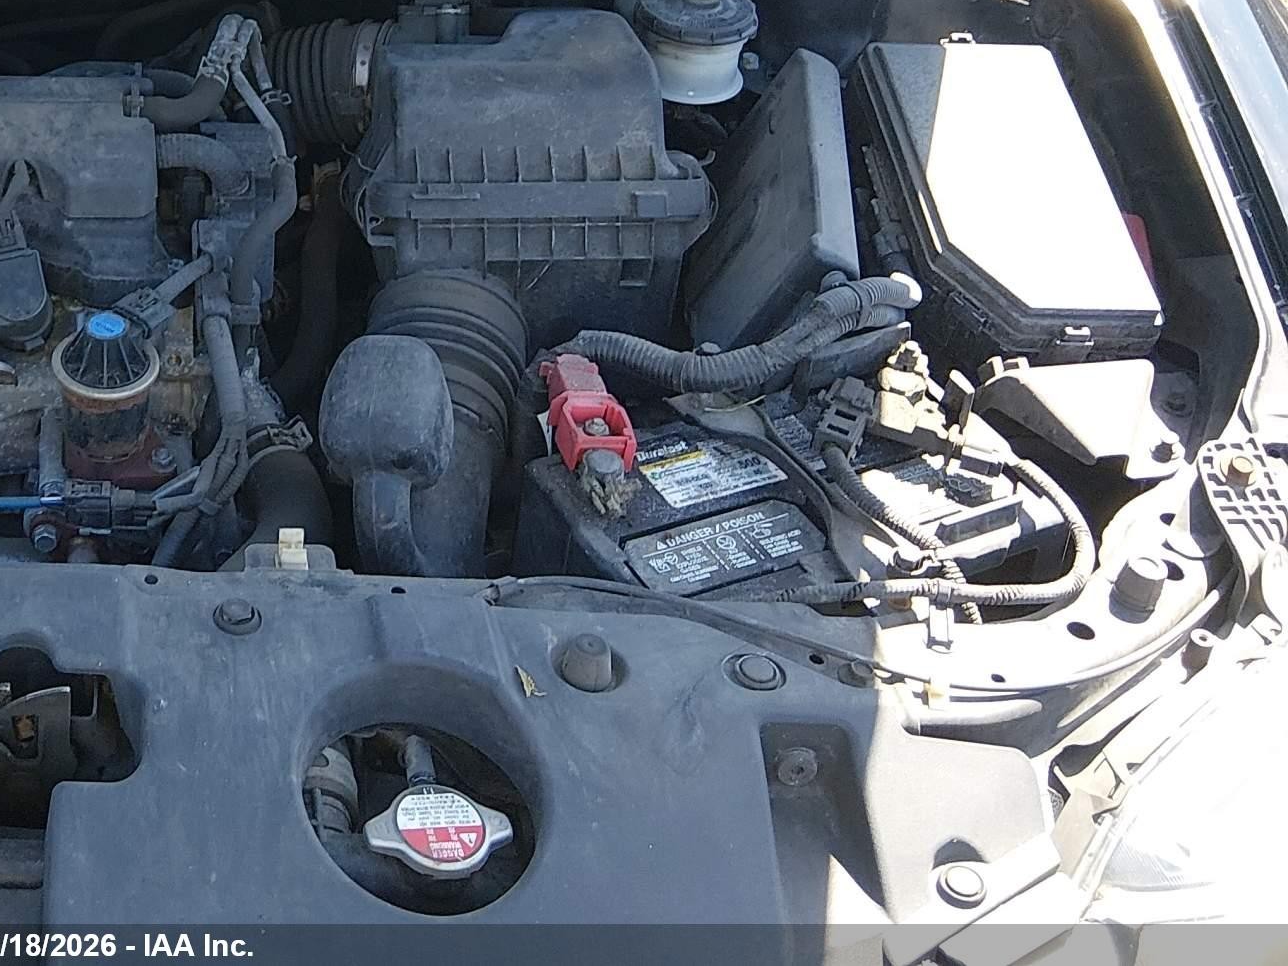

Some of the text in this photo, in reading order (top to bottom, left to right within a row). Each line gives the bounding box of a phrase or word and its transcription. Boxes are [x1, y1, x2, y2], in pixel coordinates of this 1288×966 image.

[636, 440, 689, 462] Duralast
[666, 512, 766, 547] DANGER / POISON
